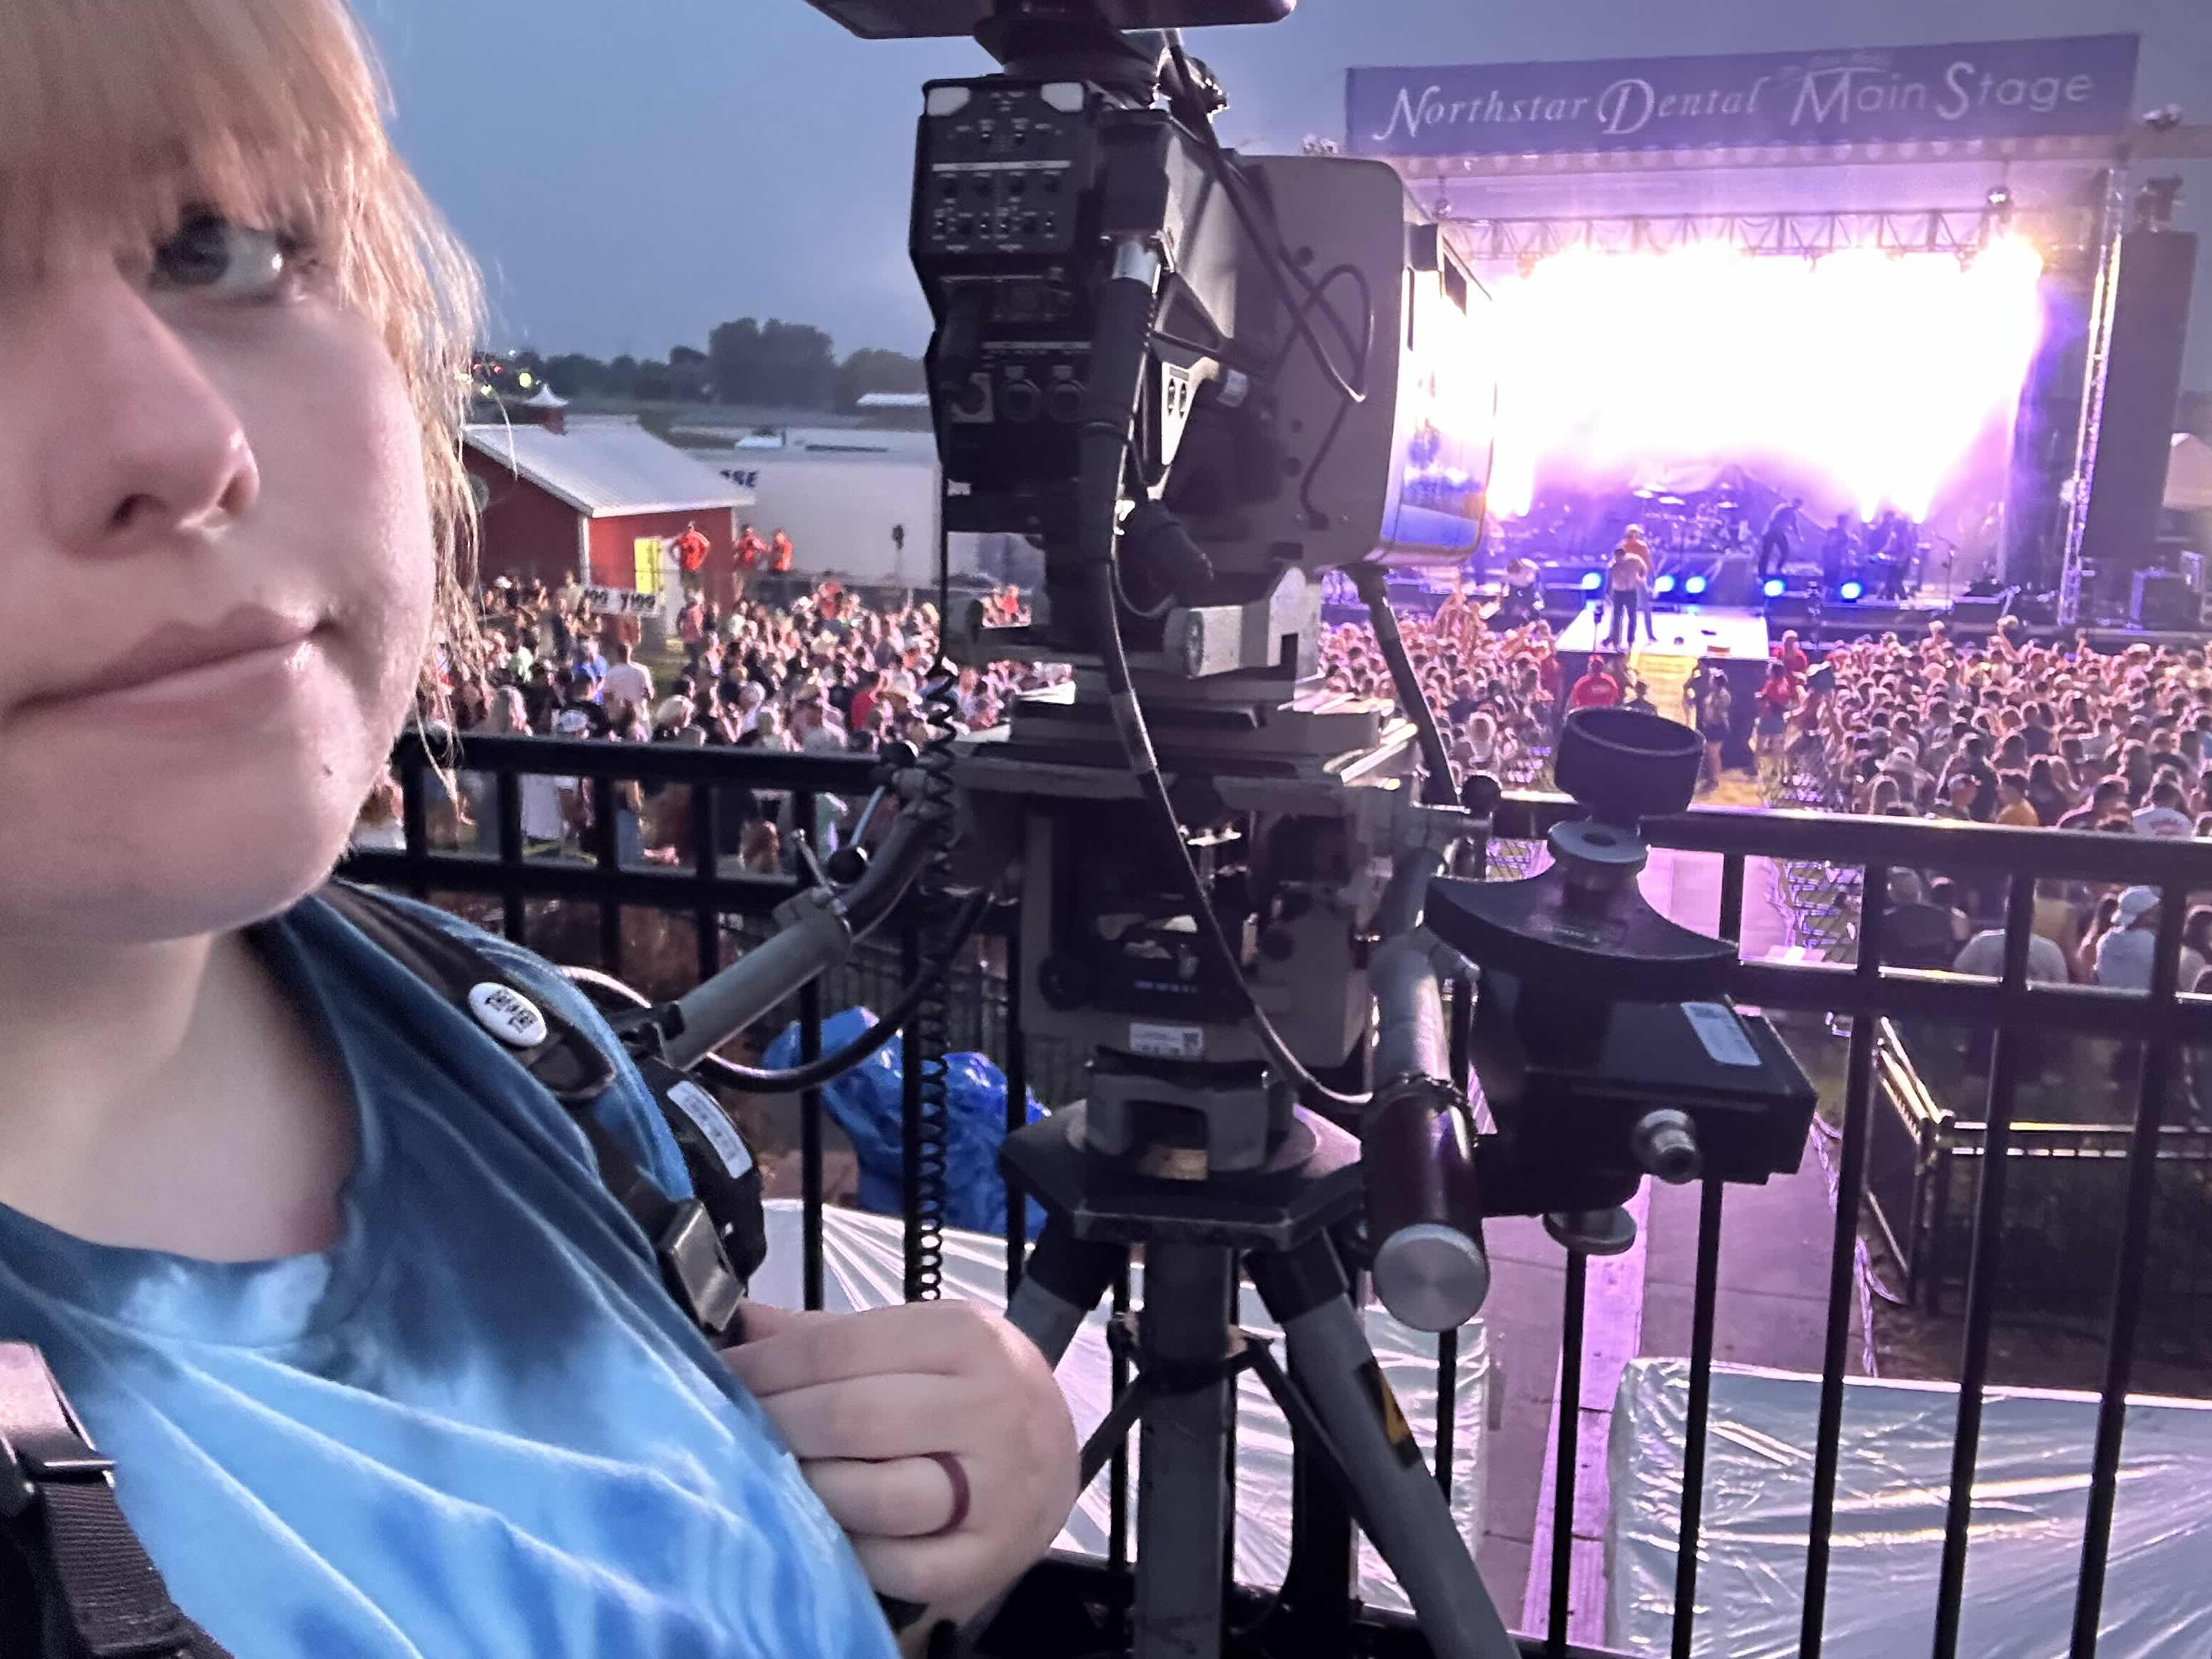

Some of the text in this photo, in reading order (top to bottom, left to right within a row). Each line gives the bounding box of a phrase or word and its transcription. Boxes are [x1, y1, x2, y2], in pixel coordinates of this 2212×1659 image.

[1372, 62, 2093, 140] Northstar Dental Main Stage
